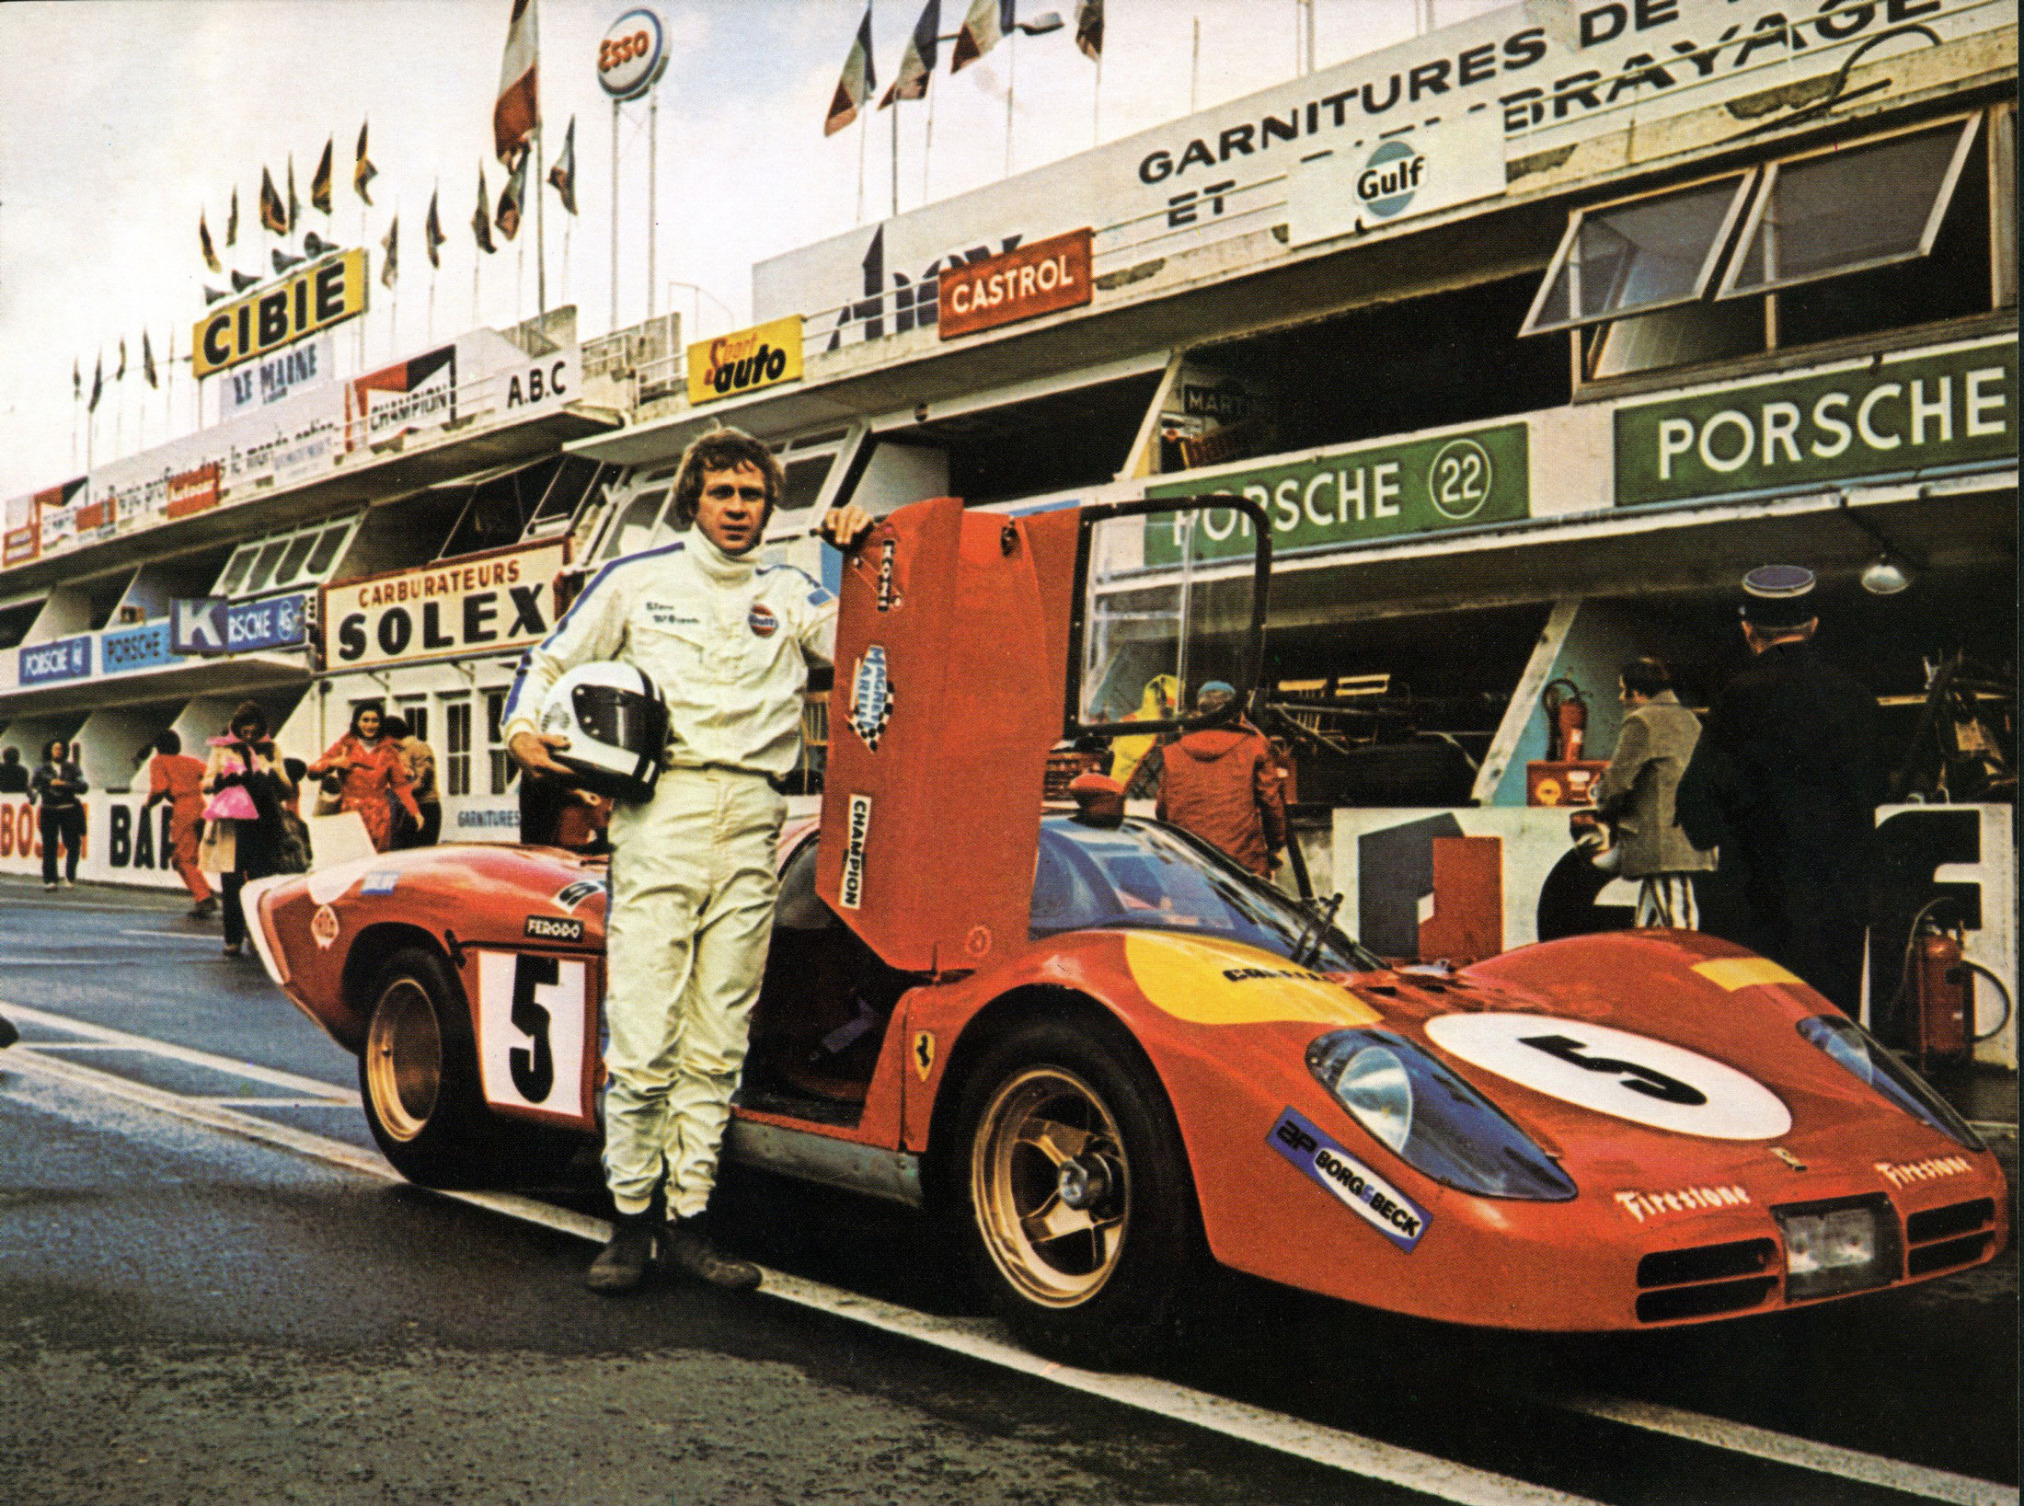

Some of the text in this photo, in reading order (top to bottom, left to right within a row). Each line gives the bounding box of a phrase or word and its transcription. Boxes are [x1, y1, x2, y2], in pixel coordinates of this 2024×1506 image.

[1139, 0, 1679, 185] GARNITURES DE
[1168, 180, 1236, 228] ET
[1357, 157, 1426, 201] Gulf
[952, 255, 1073, 314] CASTROL
[203, 261, 345, 366] CIBIE
[714, 344, 786, 393] auto
[1659, 367, 2006, 480] PORSCHE
[1440, 453, 1482, 503] 22
[359, 560, 521, 610] CARBURATEURS
[339, 584, 548, 661] SOLEX
[845, 800, 867, 906] CHAMPION
[528, 919, 581, 938] FERODO
[509, 954, 560, 1104] 5
[1517, 1035, 1707, 1106] 5
[1874, 1156, 1974, 1190] Firestone
[1615, 1184, 1751, 1223] Firestone
